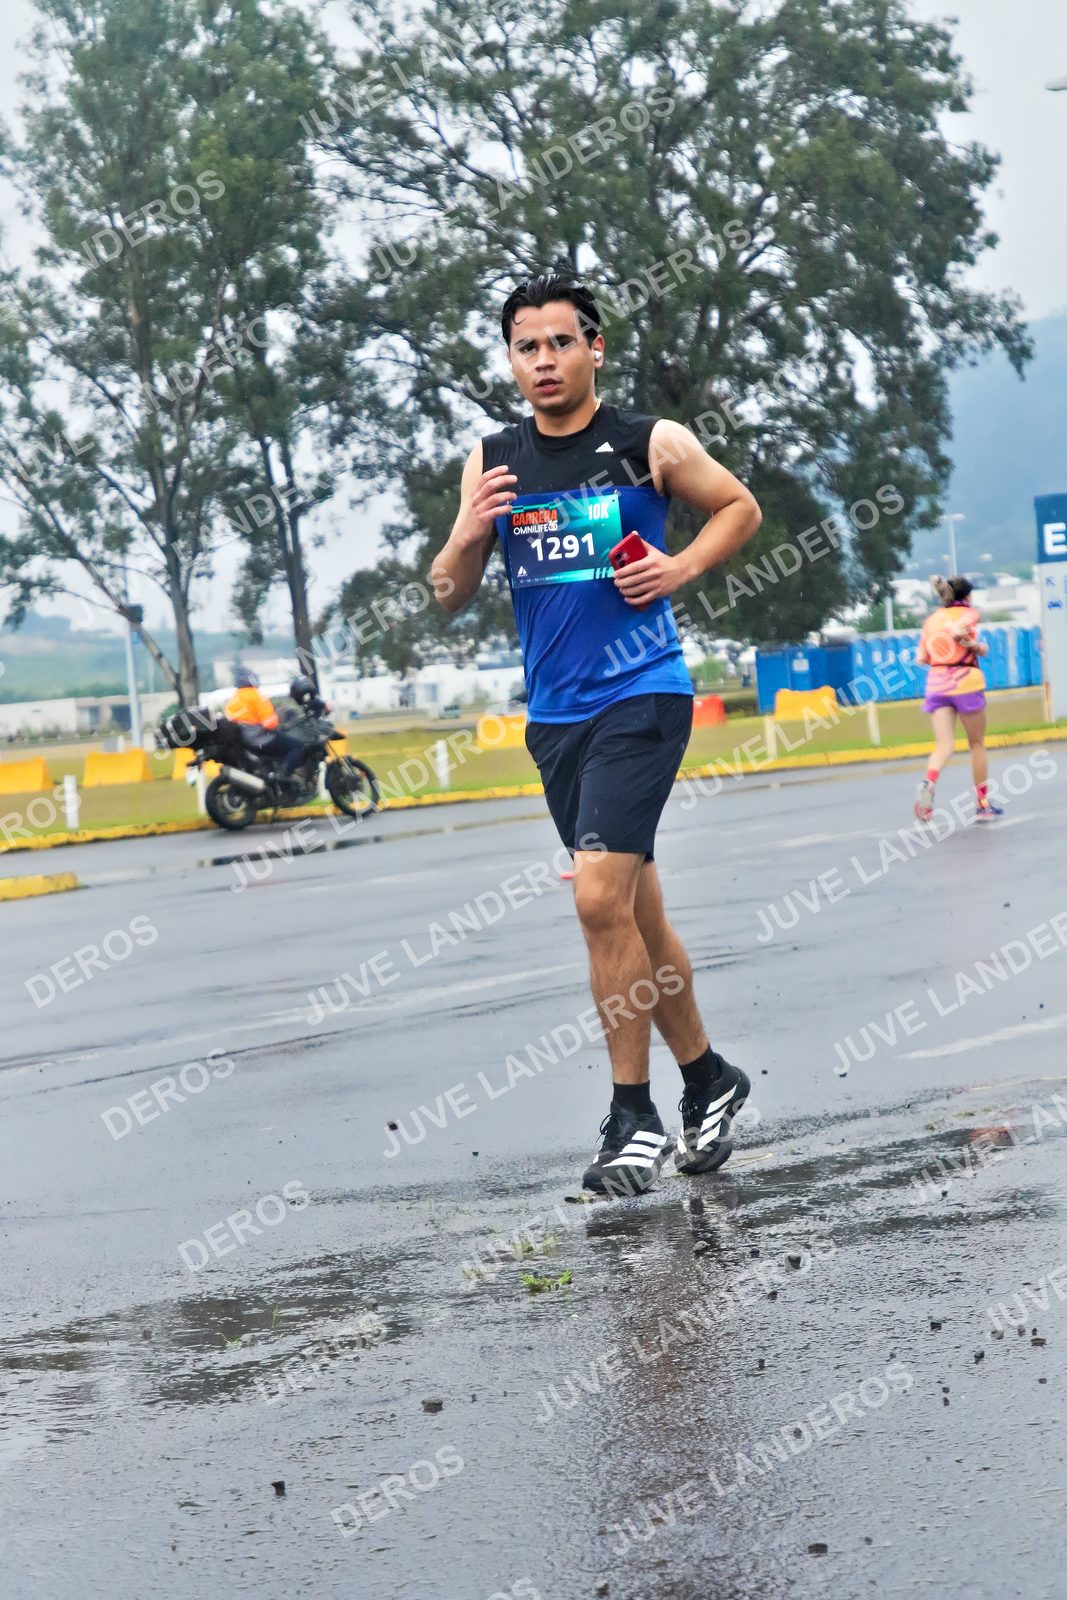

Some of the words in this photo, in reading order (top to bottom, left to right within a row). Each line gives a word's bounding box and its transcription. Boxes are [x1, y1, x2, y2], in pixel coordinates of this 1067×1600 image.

[511, 508, 558, 526] CARRERA
[588, 503, 609, 520] 10K
[531, 533, 595, 561] 1291
[1043, 522, 1066, 556] E
